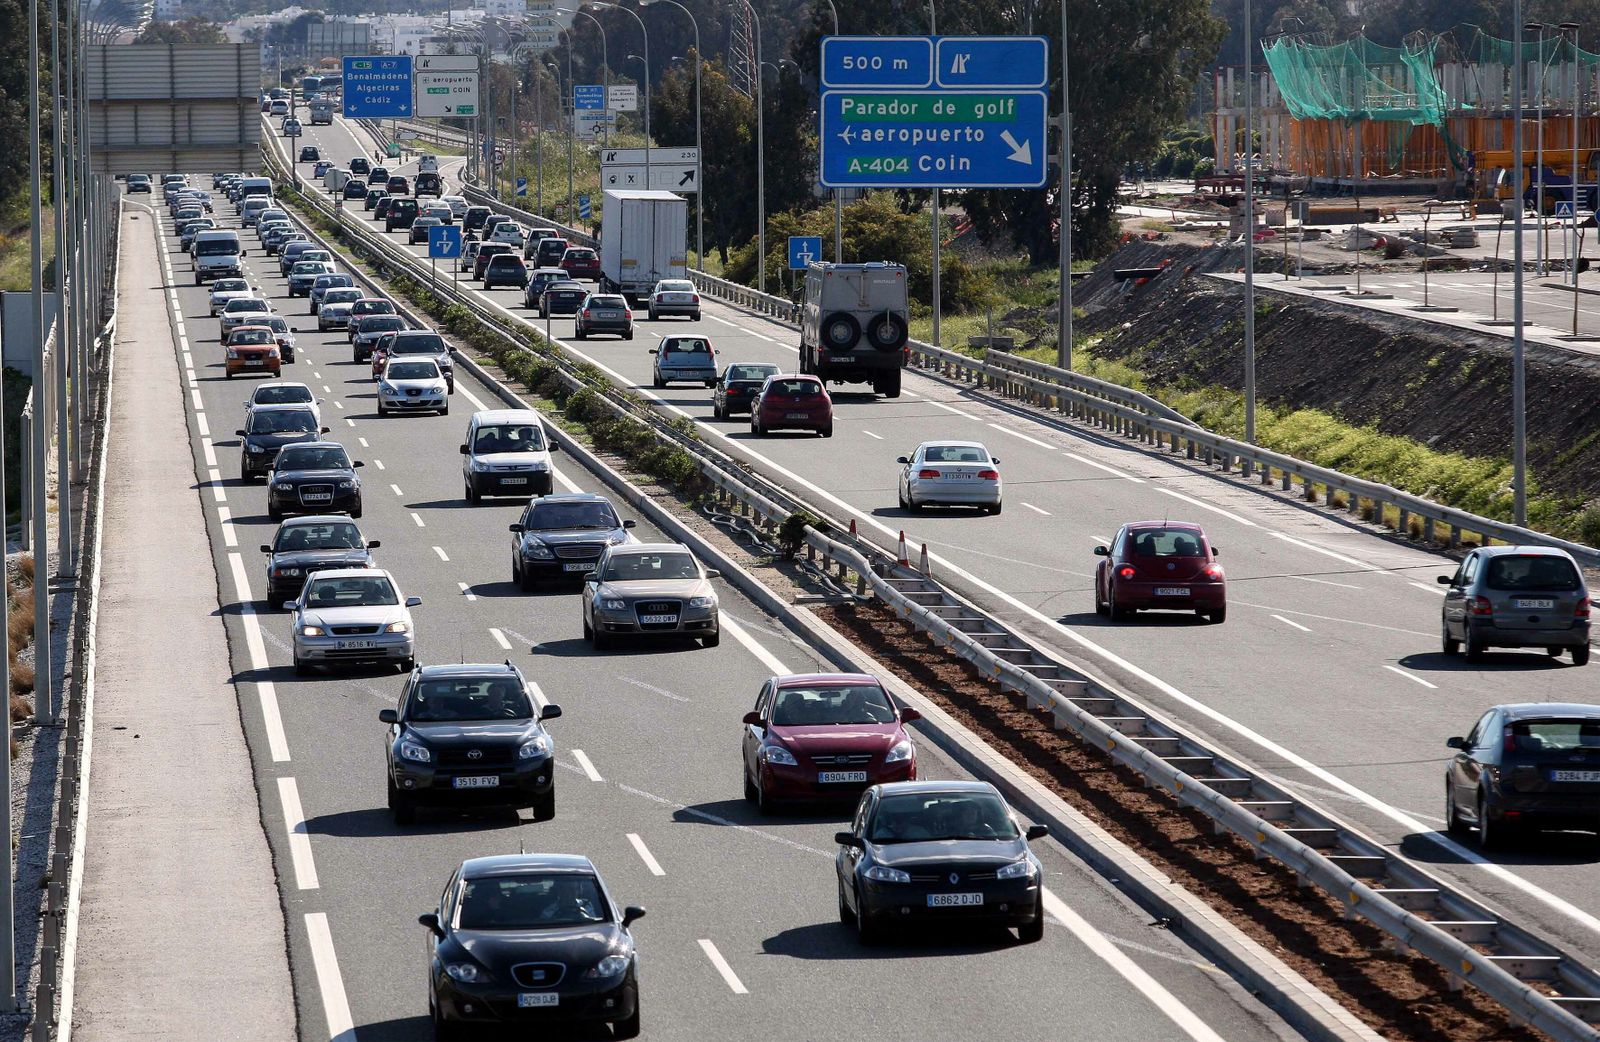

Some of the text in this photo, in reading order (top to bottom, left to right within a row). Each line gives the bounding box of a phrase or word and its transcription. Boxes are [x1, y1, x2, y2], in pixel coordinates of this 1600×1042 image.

[843, 56, 908, 70] 500 m
[433, 76, 473, 84] aeropuerto
[356, 84, 400, 93] Algeciras
[365, 96, 391, 104] Cádiz
[841, 98, 1015, 119] Parador de golf
[861, 126, 984, 146] aeropuerto
[681, 151, 696, 159] 230
[848, 154, 971, 173] A-404 Coin
[457, 776, 497, 787] 3519 FVZ
[824, 772, 865, 782] 8904 FRD
[933, 894, 982, 905] 6862 DJD
